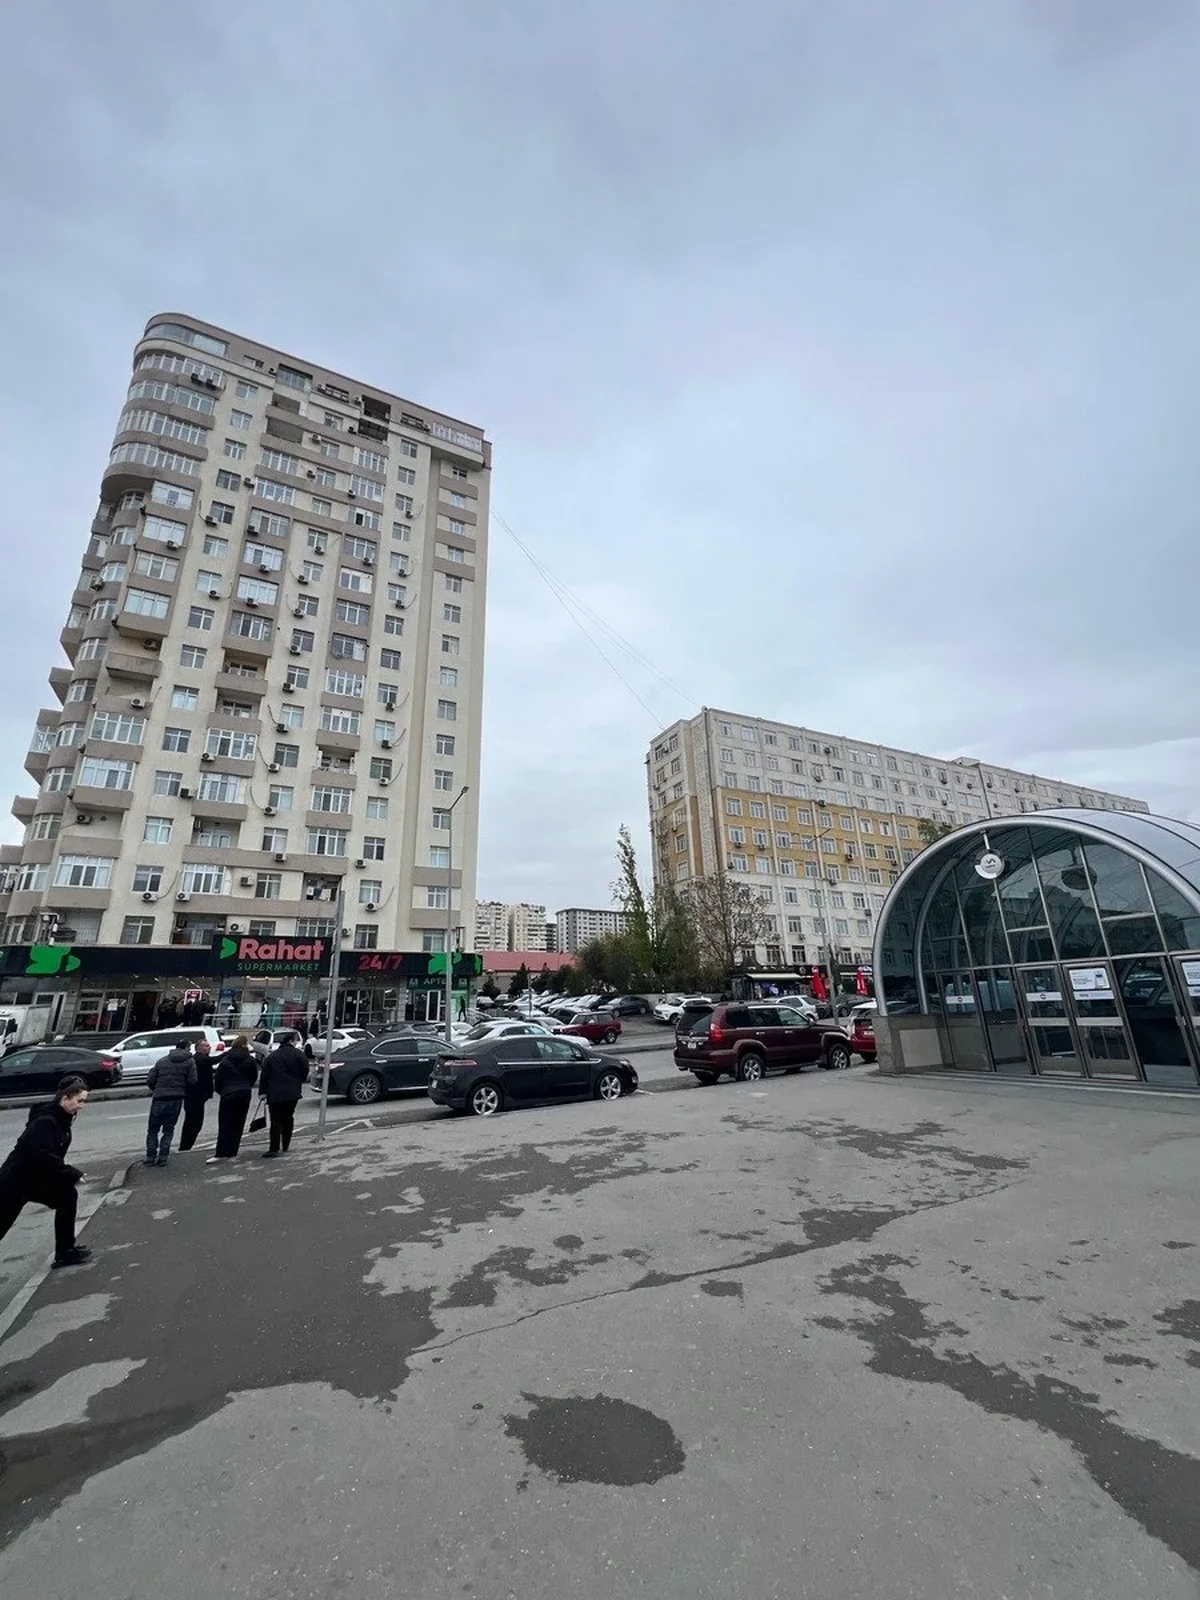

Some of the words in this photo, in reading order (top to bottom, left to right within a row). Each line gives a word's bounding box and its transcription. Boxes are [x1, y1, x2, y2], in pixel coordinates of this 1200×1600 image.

[238, 938, 324, 960] Rahat
[237, 962, 320, 972] SUPERMARKET
[358, 955, 403, 970] 24/7
[423, 977, 447, 985] APTE
